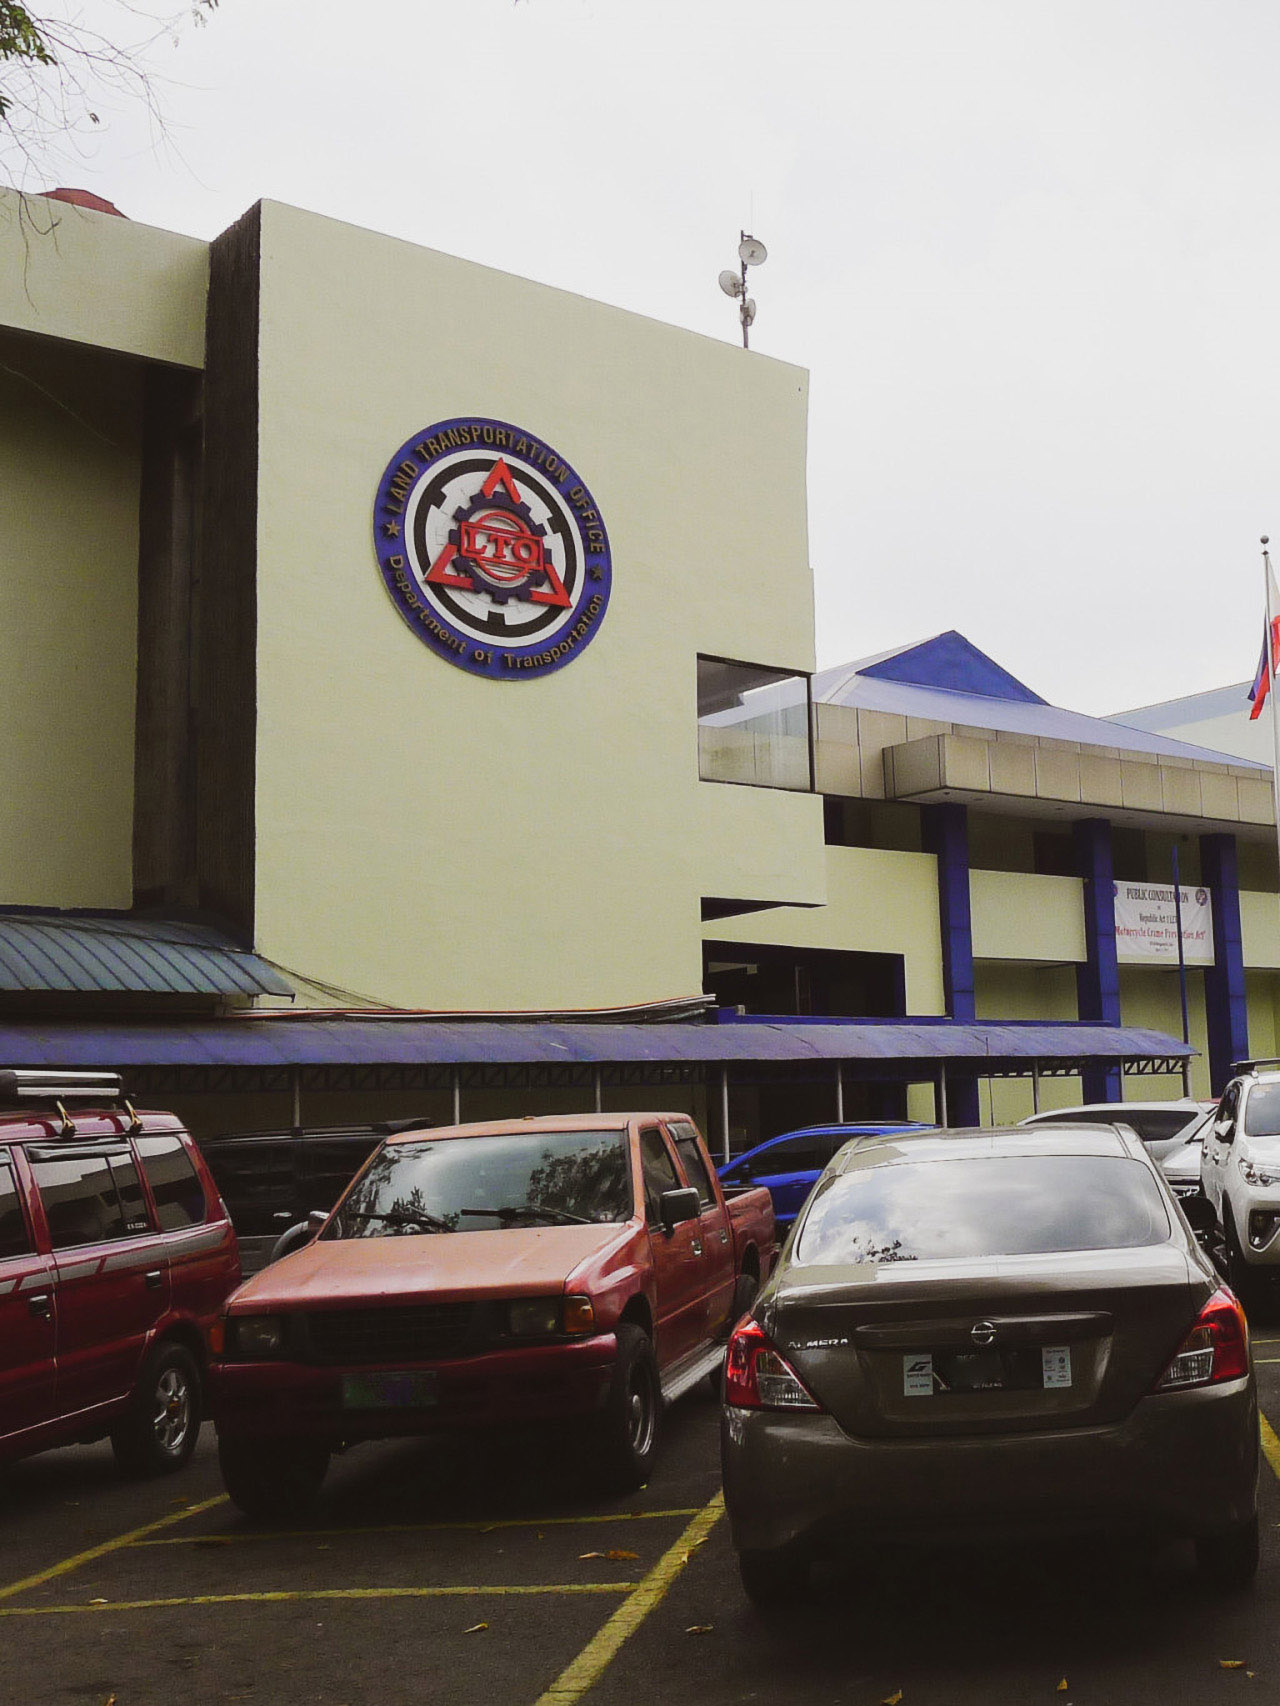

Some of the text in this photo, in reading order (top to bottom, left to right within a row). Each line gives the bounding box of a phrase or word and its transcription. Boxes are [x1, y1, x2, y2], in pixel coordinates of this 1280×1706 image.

[386, 425, 606, 555] LAND TRANSPORTATION OFFICE
[465, 528, 539, 562] LTO
[390, 554, 604, 669] Department of Transportation
